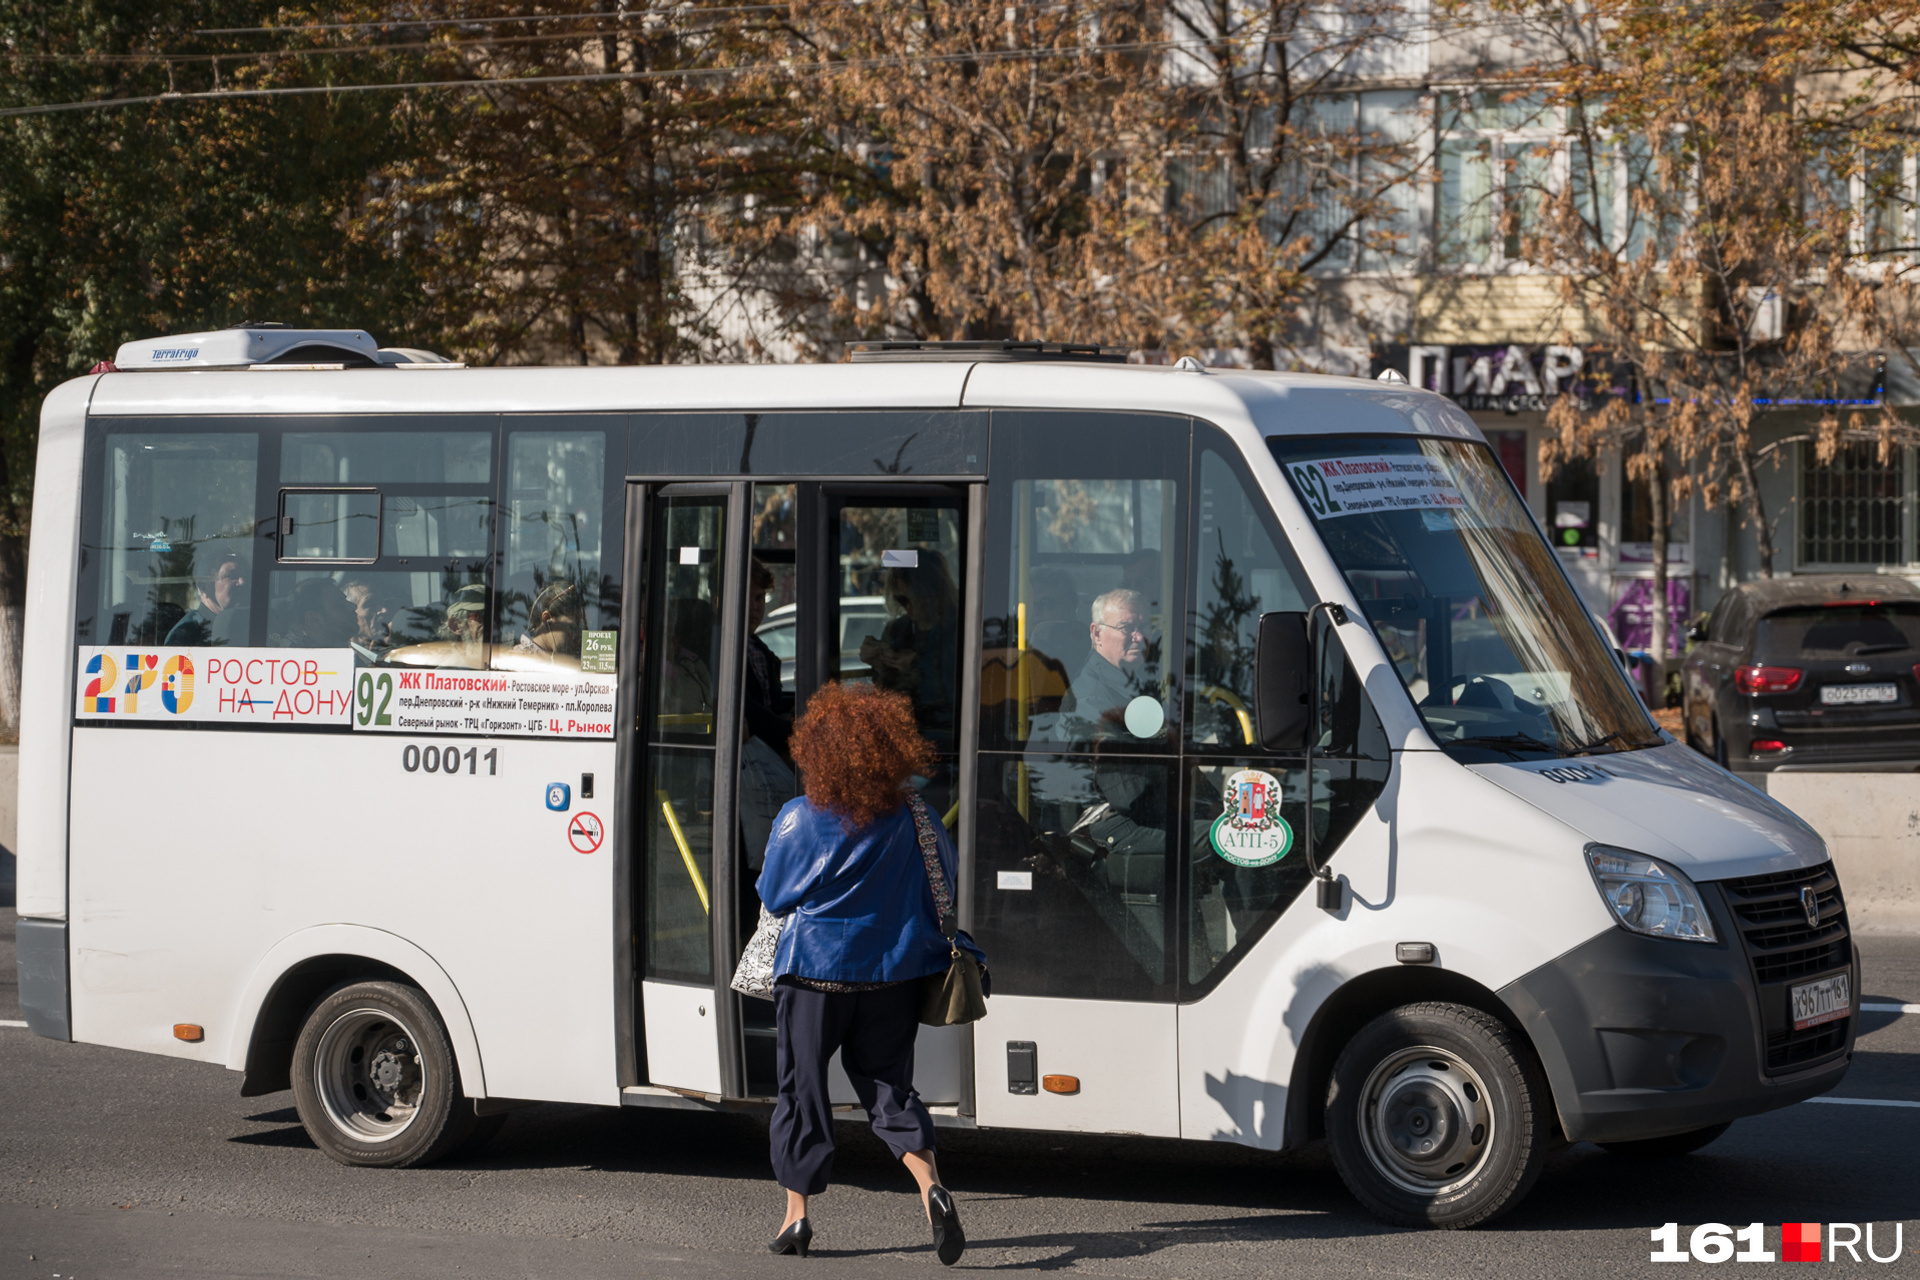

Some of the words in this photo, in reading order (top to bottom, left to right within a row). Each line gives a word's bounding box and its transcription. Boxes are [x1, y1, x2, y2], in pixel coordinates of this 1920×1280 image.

[1318, 460, 1341, 477] ЖК
[1336, 458, 1392, 475] Платовский
[1293, 464, 1342, 515] 92
[588, 631, 612, 639] ПРОЕЗД
[585, 639, 599, 651] 26
[582, 660, 590, 670] 23
[83, 651, 195, 715] 270
[399, 672, 422, 690] ЖК
[425, 673, 507, 692] Платовский
[511, 680, 551, 693] Ростовское
[552, 684, 569, 696] море
[356, 672, 393, 726] 92
[398, 715, 435, 730] Северный
[435, 718, 458, 730] рынок
[464, 717, 479, 731] ТРЦ
[528, 719, 543, 731] ЦГБ
[549, 719, 563, 734] Ц.
[568, 719, 611, 733] Рынок
[402, 744, 498, 776] 00011
[1539, 764, 1618, 784] 00011
[1223, 832, 1279, 849] АТП-5
